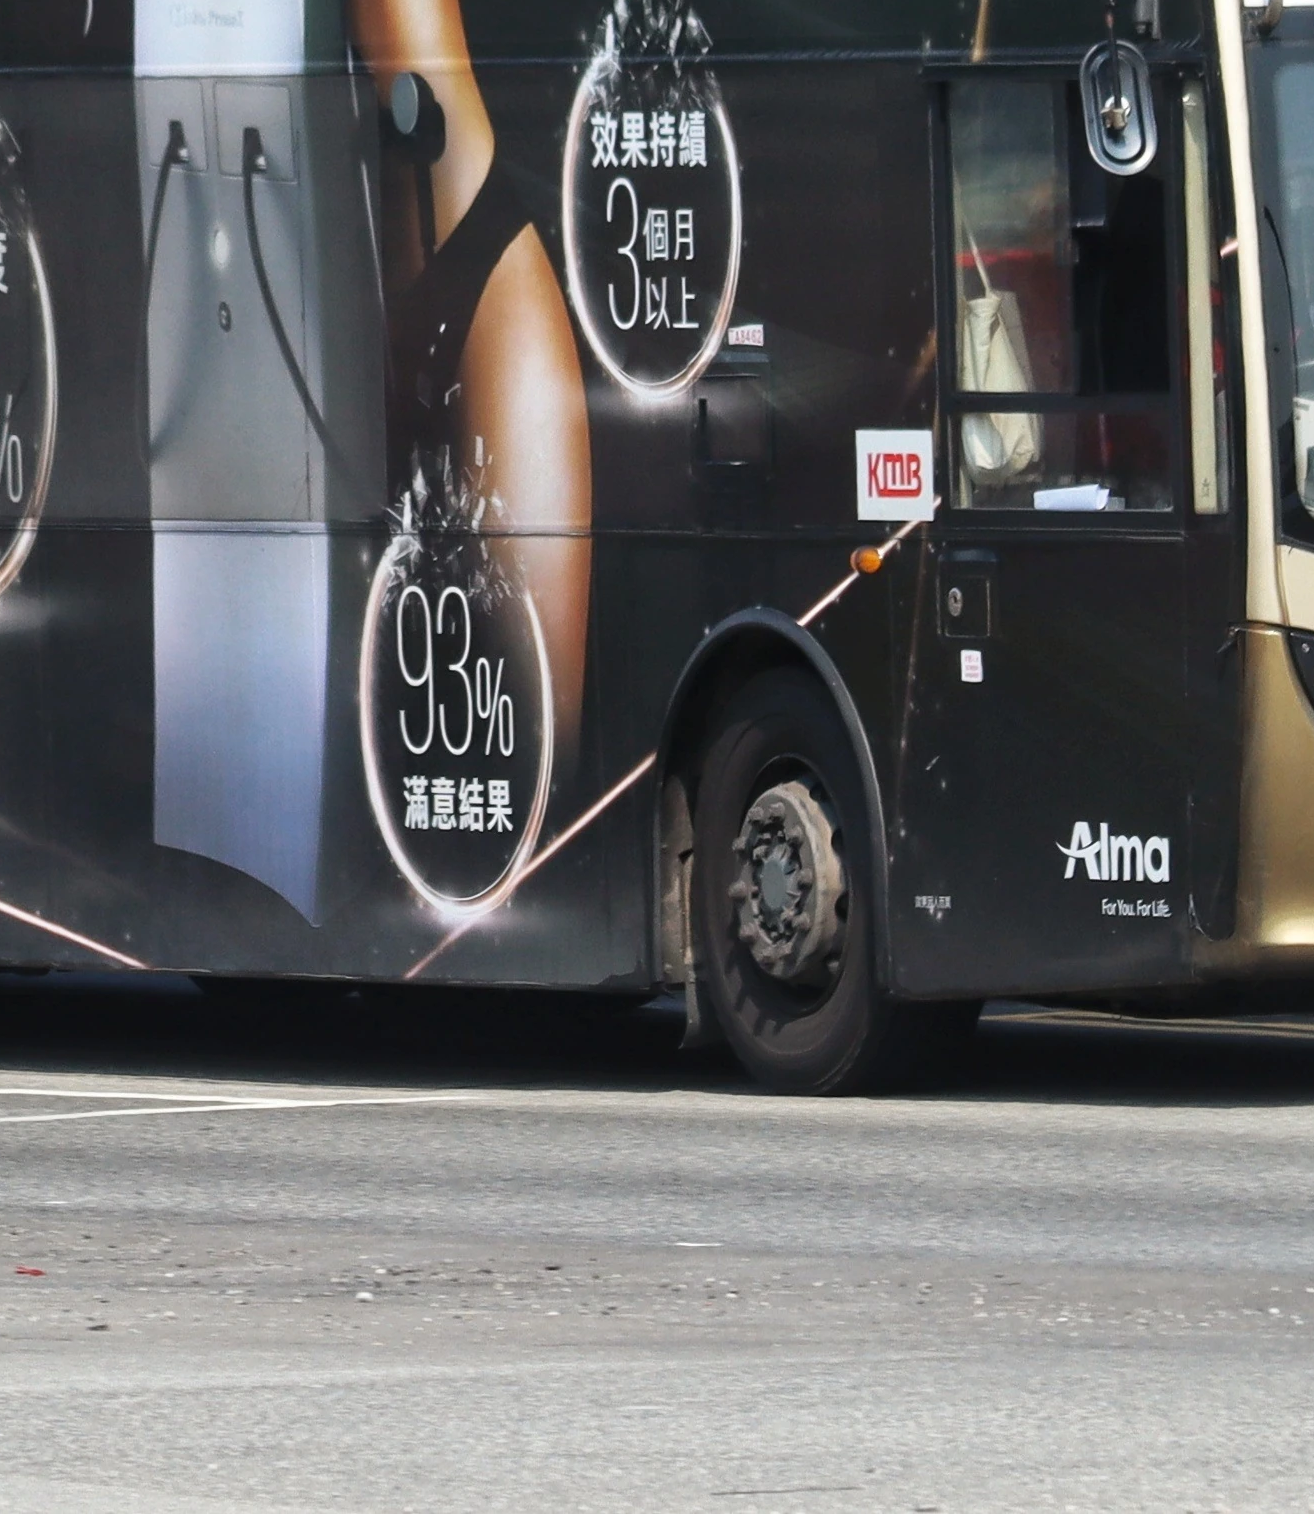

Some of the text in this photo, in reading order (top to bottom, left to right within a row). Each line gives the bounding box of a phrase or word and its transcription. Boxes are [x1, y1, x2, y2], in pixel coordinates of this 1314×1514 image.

[591, 111, 708, 169] 效果持續
[867, 452, 923, 499] KMB
[397, 585, 514, 757] 93%
[403, 776, 514, 833] 滿意結果
[1056, 820, 1171, 883] Alma
[1101, 898, 1117, 916] For
[1137, 898, 1152, 917] For
